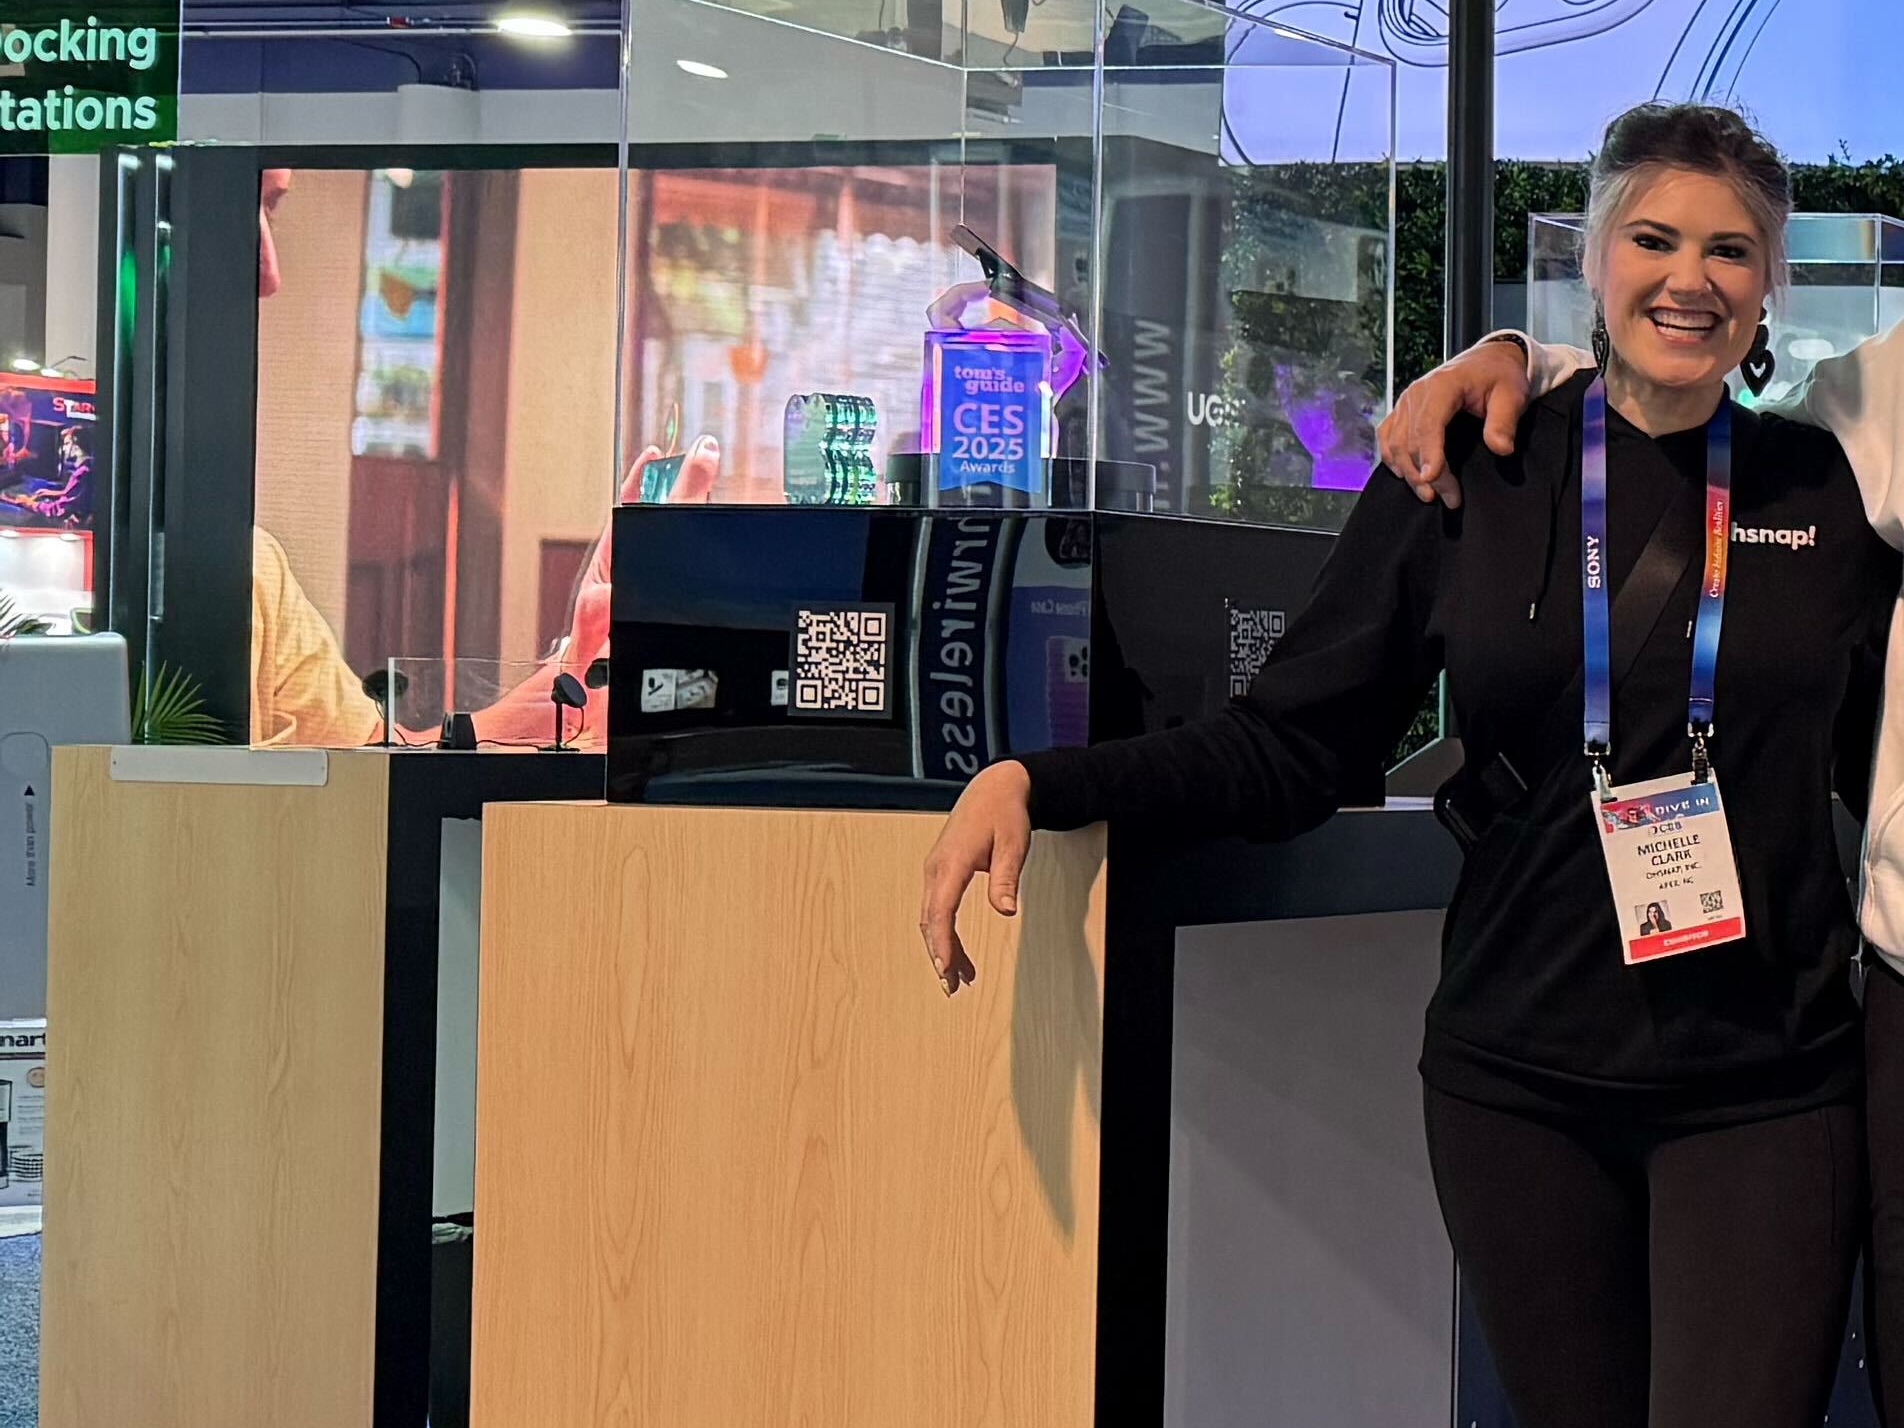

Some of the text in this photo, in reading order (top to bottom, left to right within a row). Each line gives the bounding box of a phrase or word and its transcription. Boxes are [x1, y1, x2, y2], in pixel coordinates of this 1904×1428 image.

[0, 15, 157, 71] ocking
[964, 377, 1025, 396] guide
[952, 402, 1025, 436] CES
[951, 436, 1025, 460] 2025
[959, 459, 1016, 474] Awards
[1730, 521, 1817, 551] hsnap!
[1586, 534, 1602, 589] SONY
[1655, 796, 1711, 816] DIVE IN
[1637, 834, 1701, 856] MICHELLE
[1651, 849, 1692, 866] CLARK
